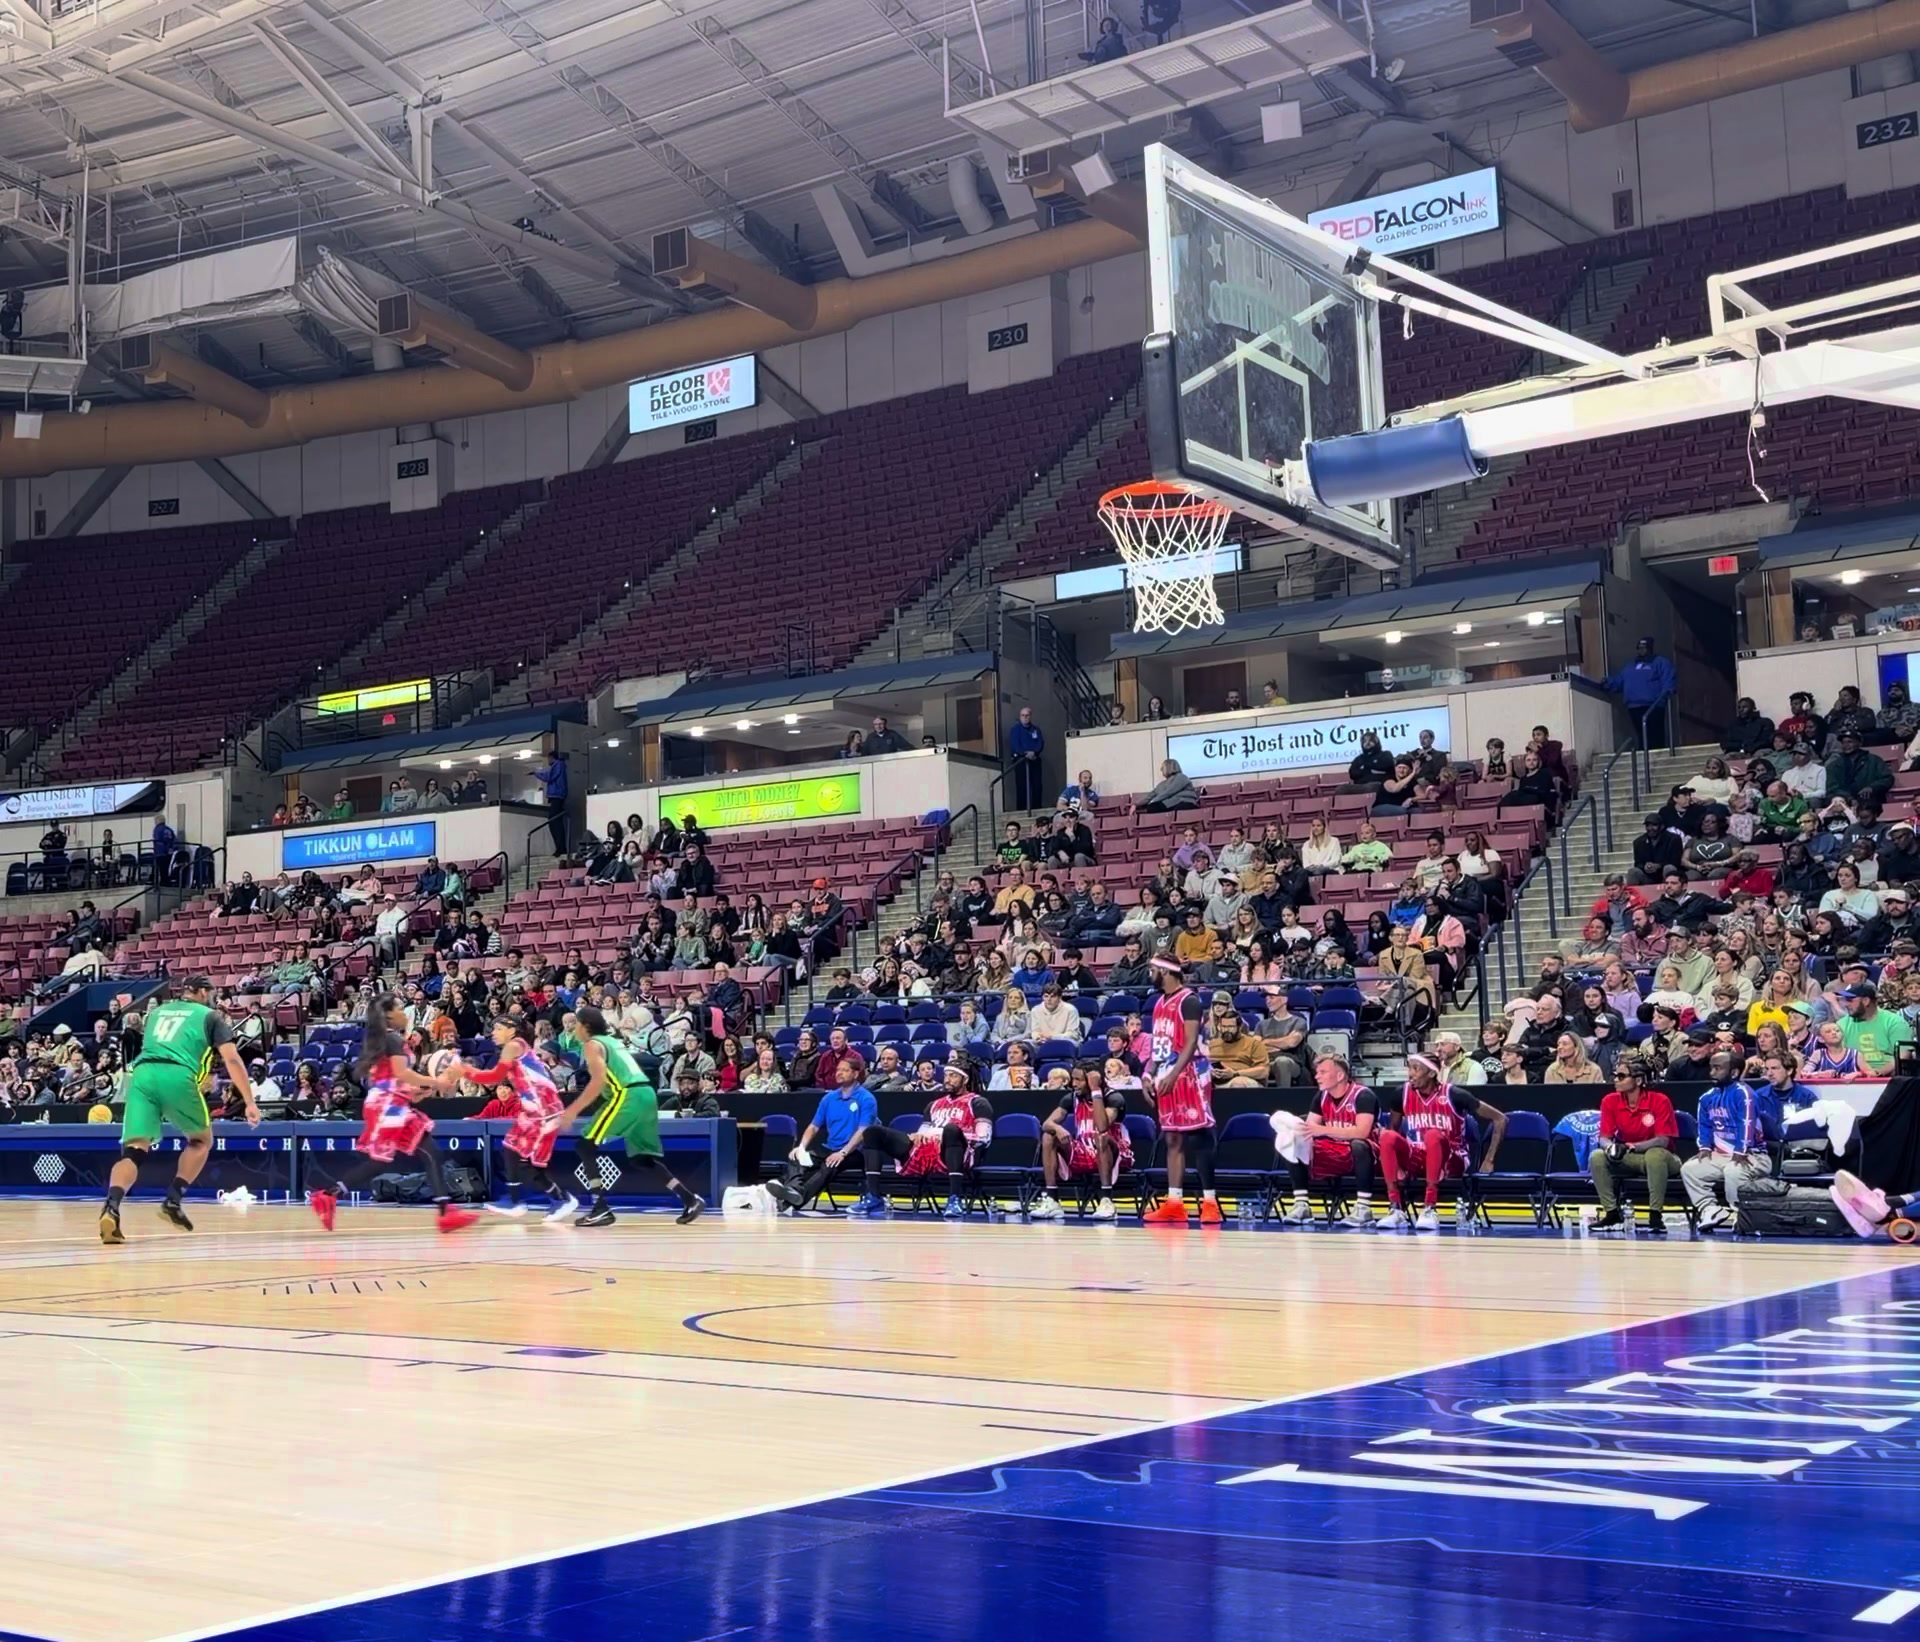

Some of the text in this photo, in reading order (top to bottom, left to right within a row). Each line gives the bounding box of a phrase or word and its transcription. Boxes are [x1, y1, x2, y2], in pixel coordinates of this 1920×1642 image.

[1863, 117, 1912, 144] 232
[1375, 210, 1489, 244] GRAPHIC PRINT STUDIO
[992, 327, 1025, 348] 230
[650, 373, 705, 399] FLOOR
[650, 387, 705, 413] DECOR
[651, 396, 731, 422] TILE WOOD STONE
[687, 424, 714, 441] 229
[400, 461, 427, 476] 228
[151, 501, 177, 514] 227
[1202, 739, 1237, 761] The
[1241, 732, 1284, 759] Post
[1289, 728, 1325, 749] and
[1241, 749, 1362, 770] postandcourier.co
[715, 783, 801, 808] AUTO MONEY
[721, 805, 797, 824] TITLE LOANS
[303, 833, 362, 857] TIKKUN
[1152, 1036, 1172, 1060] 53
[1407, 1113, 1453, 1131] HARLEM
[259, 1138, 486, 1151] CHARLON
